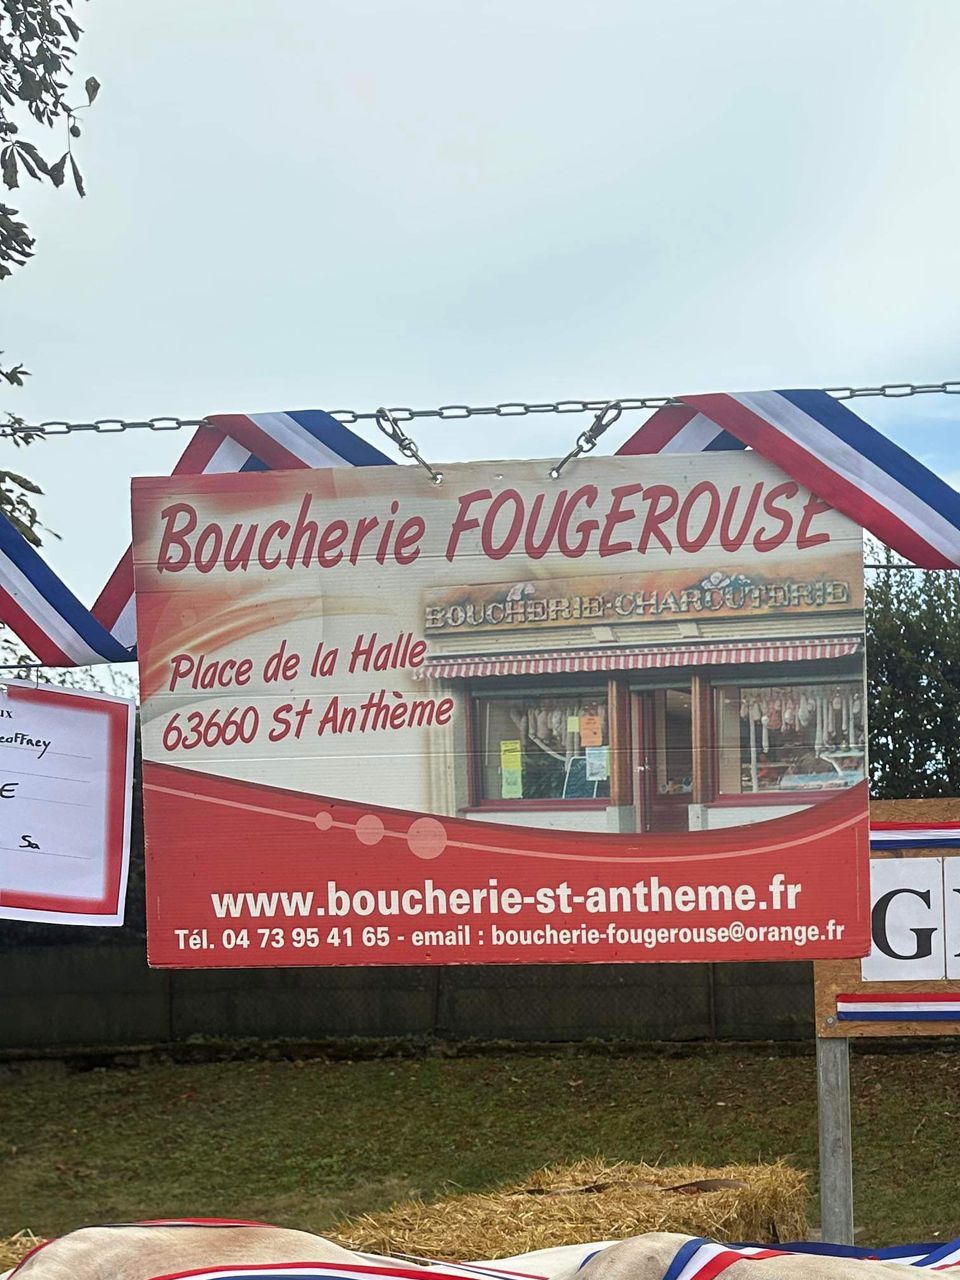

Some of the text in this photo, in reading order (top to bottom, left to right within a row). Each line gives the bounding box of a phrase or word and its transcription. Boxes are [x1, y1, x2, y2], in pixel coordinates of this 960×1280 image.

[156, 480, 832, 574] Boucherie FOUGEROUSE
[168, 632, 428, 692] Place de la Halle
[162, 689, 454, 752] 63660 St Anthème
[211, 873, 802, 918] www.boucherie-st-antheme.fr
[174, 928, 214, 950] Tél.
[222, 928, 250, 949] 04
[257, 927, 285, 948] 73
[291, 927, 319, 948] 95
[326, 927, 353, 947] 41
[361, 926, 390, 947] 65
[411, 925, 471, 946] email
[491, 919, 845, 949] boucherie-fougerouse@orange.fr
